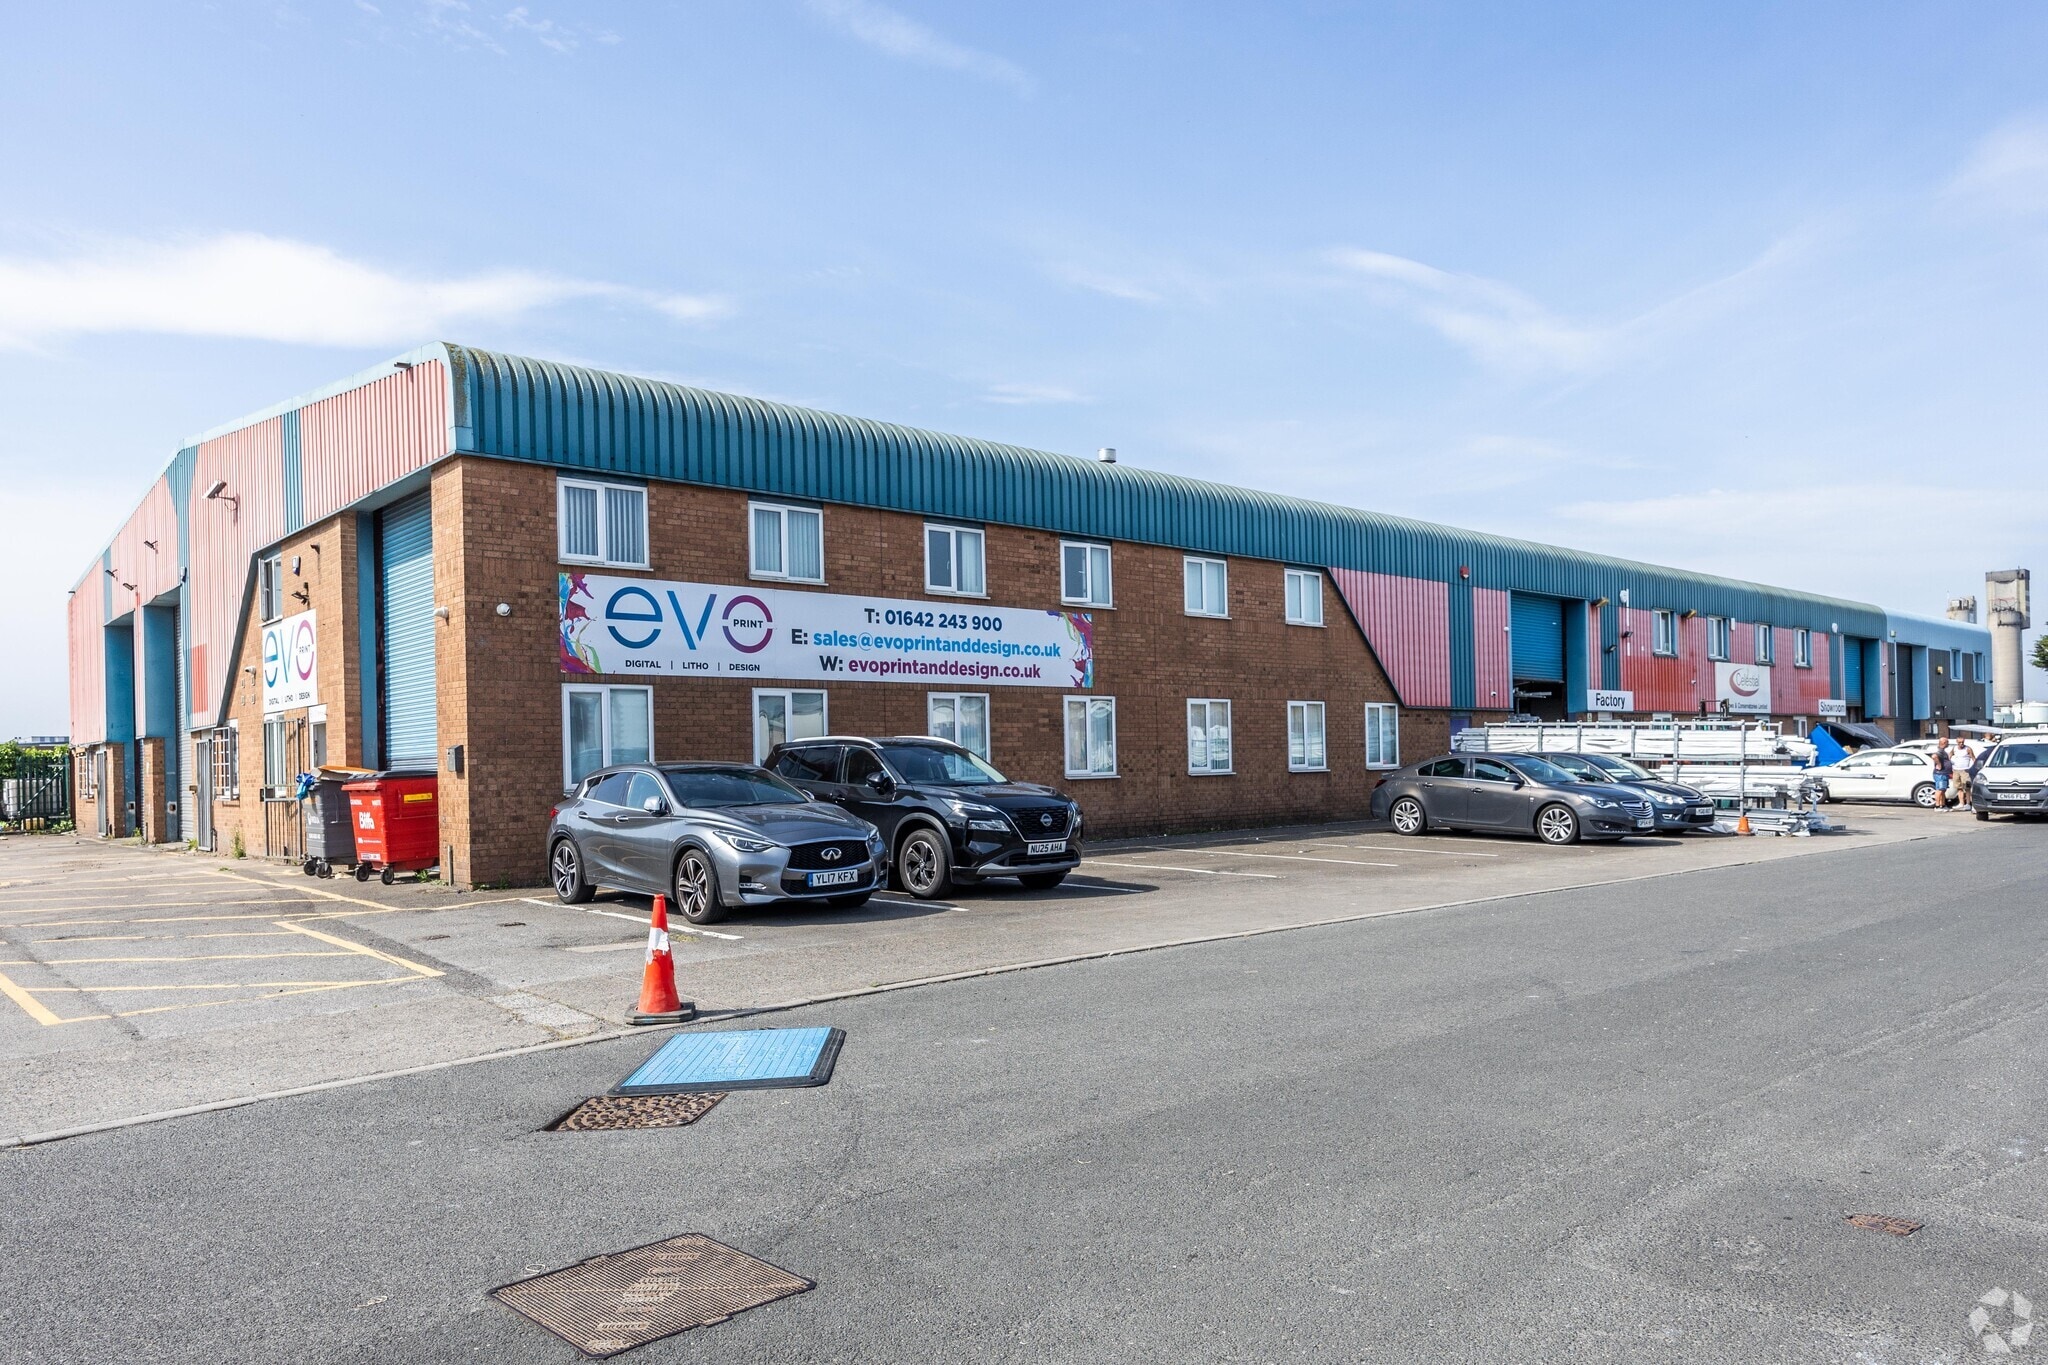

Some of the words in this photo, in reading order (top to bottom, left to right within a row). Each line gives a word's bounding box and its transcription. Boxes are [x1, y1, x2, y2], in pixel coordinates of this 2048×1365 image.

[733, 618, 764, 629] PRINT
[864, 608, 880, 624] T:
[884, 610, 933, 627] 01642
[938, 613, 968, 630] 243
[972, 616, 1002, 632] 900
[791, 628, 808, 645] E:
[813, 630, 1061, 658] sales@evoprintanddesign.co.uk
[625, 660, 661, 669] DIGITAL
[682, 662, 709, 670] LITHO
[729, 663, 760, 672] DESIGN
[819, 655, 843, 672] W:
[848, 657, 1041, 679] evoprintanddesign.co.uk
[1735, 670, 1760, 687] Celestial
[1595, 692, 1626, 710] Factory
[1820, 701, 1845, 713] Showroom
[1030, 844, 1049, 853] NU25
[816, 873, 836, 885] YL17
[837, 871, 855, 882] KFX
